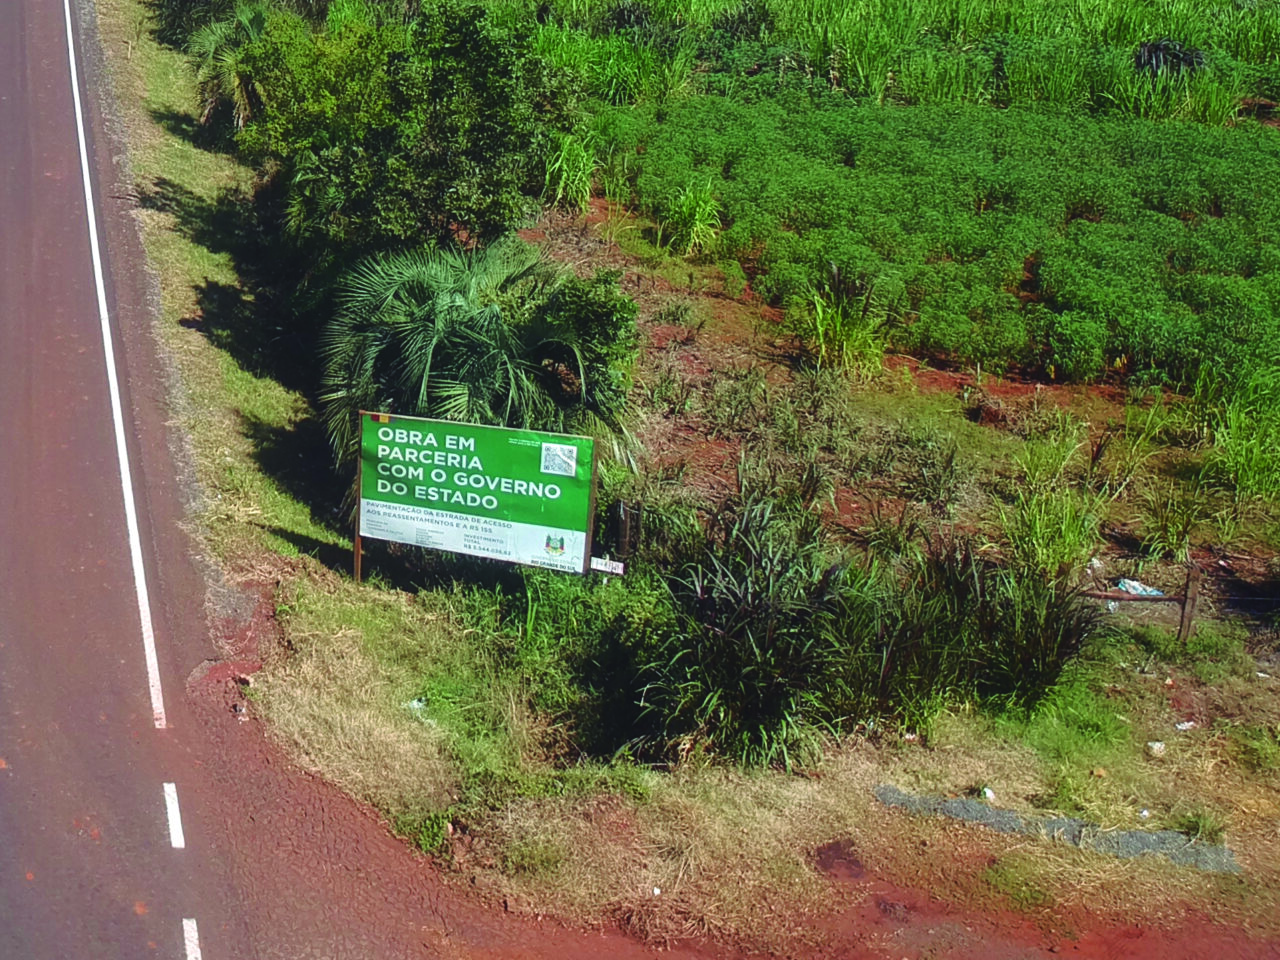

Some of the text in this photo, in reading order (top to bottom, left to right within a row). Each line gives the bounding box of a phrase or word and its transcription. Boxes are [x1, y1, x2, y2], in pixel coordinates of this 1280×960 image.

[378, 427, 475, 451] OBRA EM
[377, 444, 483, 470] PARCERIA
[377, 463, 561, 499] COM O GOVERNO
[377, 479, 498, 509] DO ESTADO
[366, 501, 422, 514] PAVIMENTAÇÃO
[435, 512, 469, 521] ESTRADA
[483, 520, 512, 528] ACESSO
[383, 511, 454, 527] REASSENTAMENTOS
